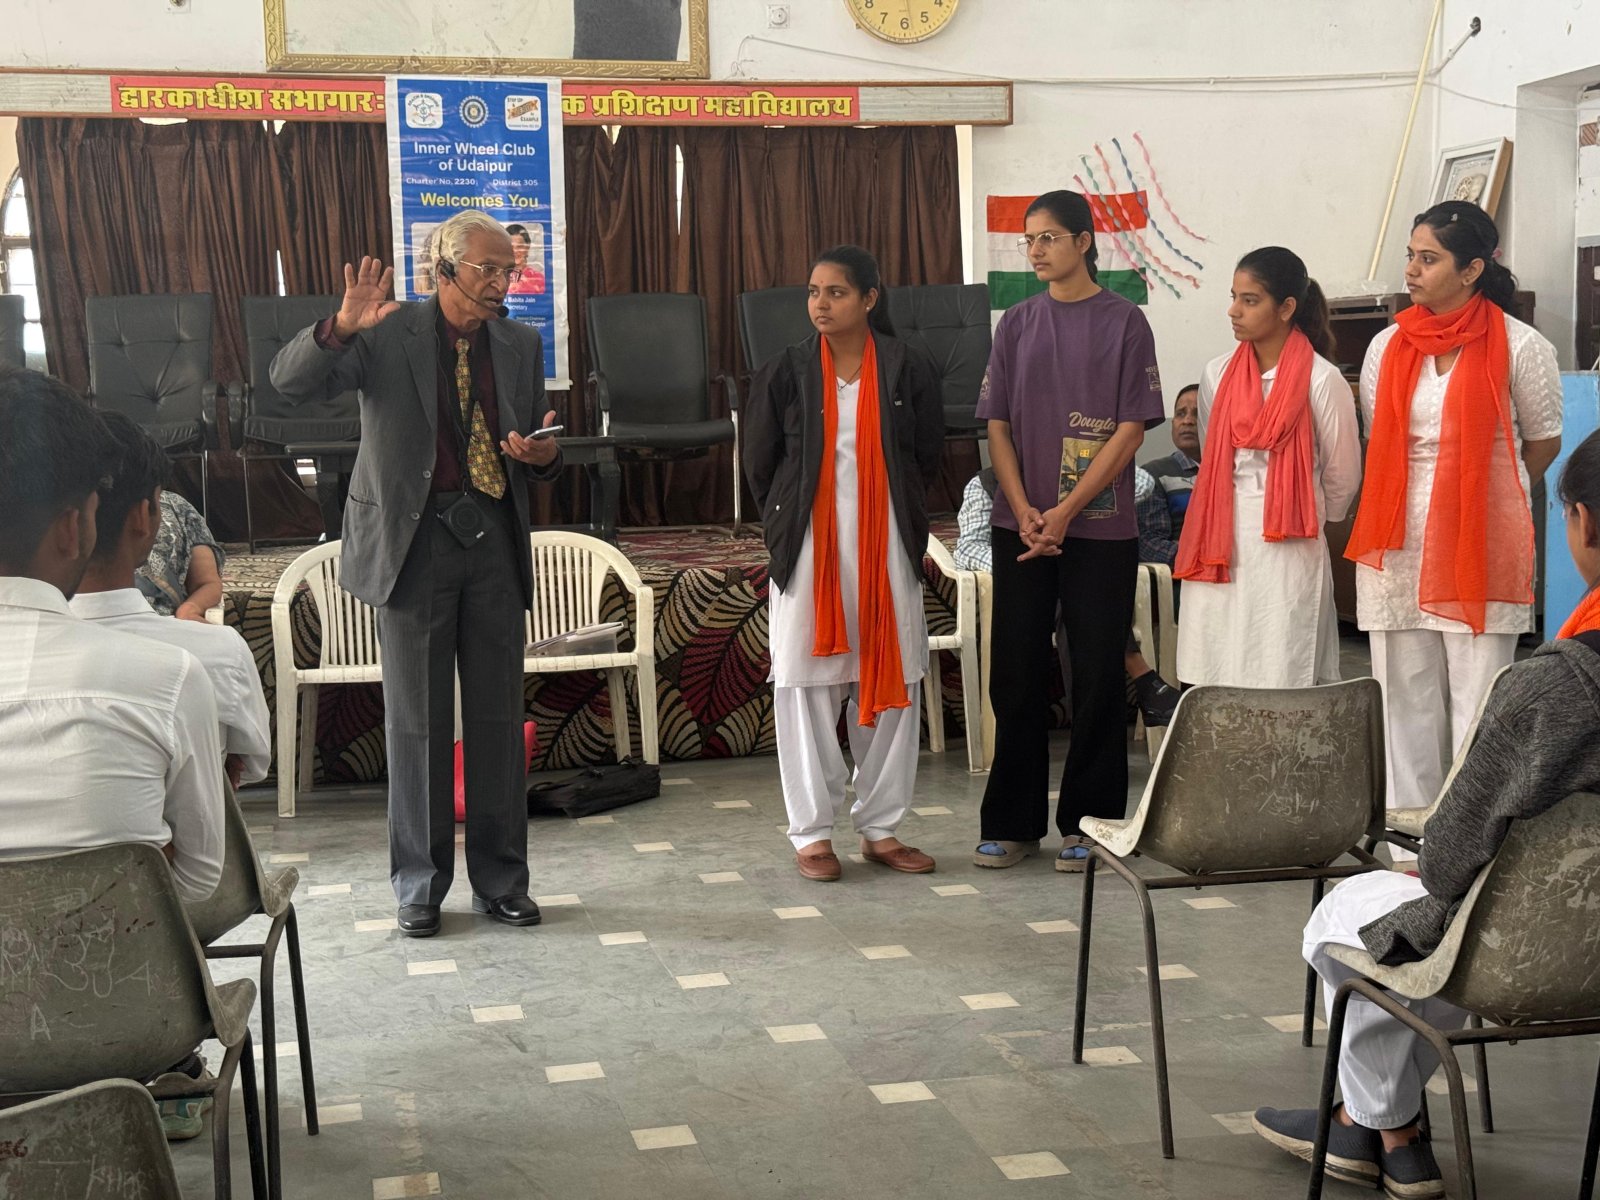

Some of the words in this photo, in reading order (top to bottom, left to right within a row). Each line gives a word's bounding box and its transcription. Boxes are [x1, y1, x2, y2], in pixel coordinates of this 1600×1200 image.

[880, 12, 888, 25] 7
[900, 17, 910, 30] 6
[921, 11, 929, 24] 5
[118, 82, 264, 111] द्वारकाधीश
[591, 89, 701, 117] प्रशिक्षण
[703, 90, 853, 117] महाविद्यालय
[414, 141, 451, 155] Inner
[455, 142, 499, 155] Wheel
[502, 143, 536, 156] Club
[438, 159, 453, 171] of
[456, 159, 513, 174] Udaipur
[406, 177, 437, 185] Charter
[492, 178, 522, 187] District
[523, 179, 539, 187] 305
[420, 192, 504, 207] Welcomes
[508, 193, 539, 208] You
[1068, 411, 1117, 433] Dougla
